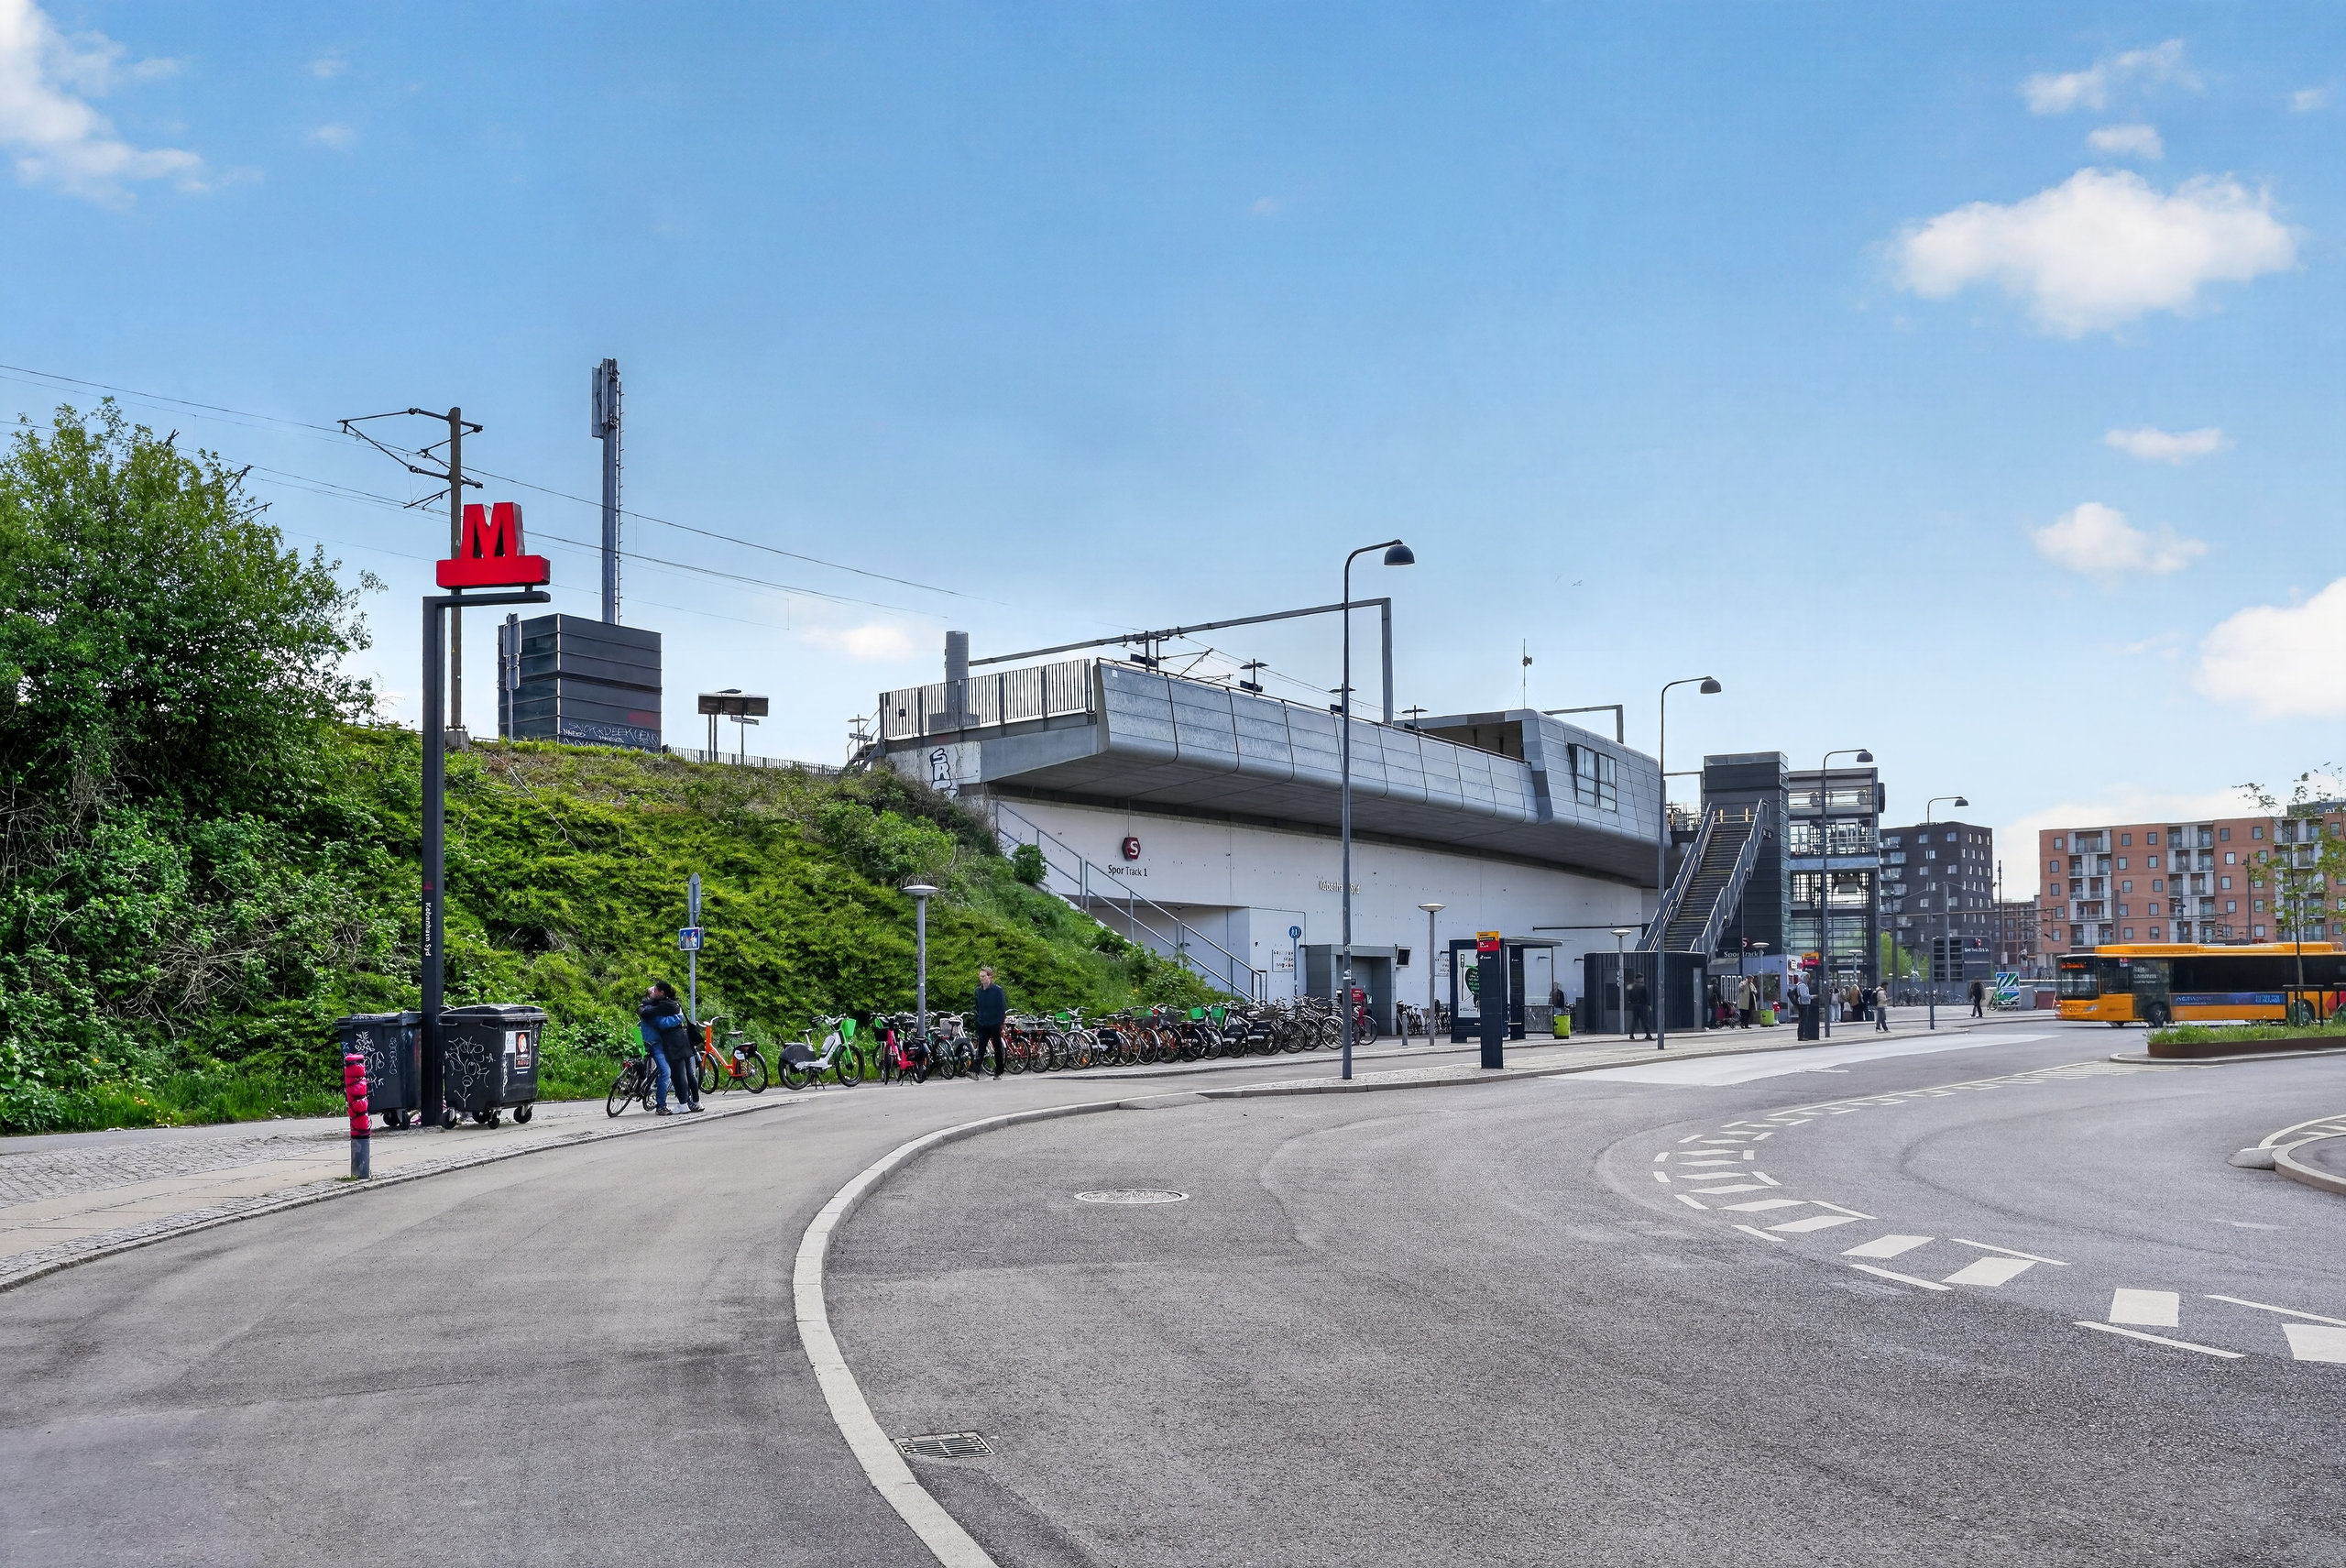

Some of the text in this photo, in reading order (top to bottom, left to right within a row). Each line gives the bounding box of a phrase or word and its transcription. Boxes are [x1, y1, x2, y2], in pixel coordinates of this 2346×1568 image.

[1108, 864, 1148, 877] Spor Track 1
